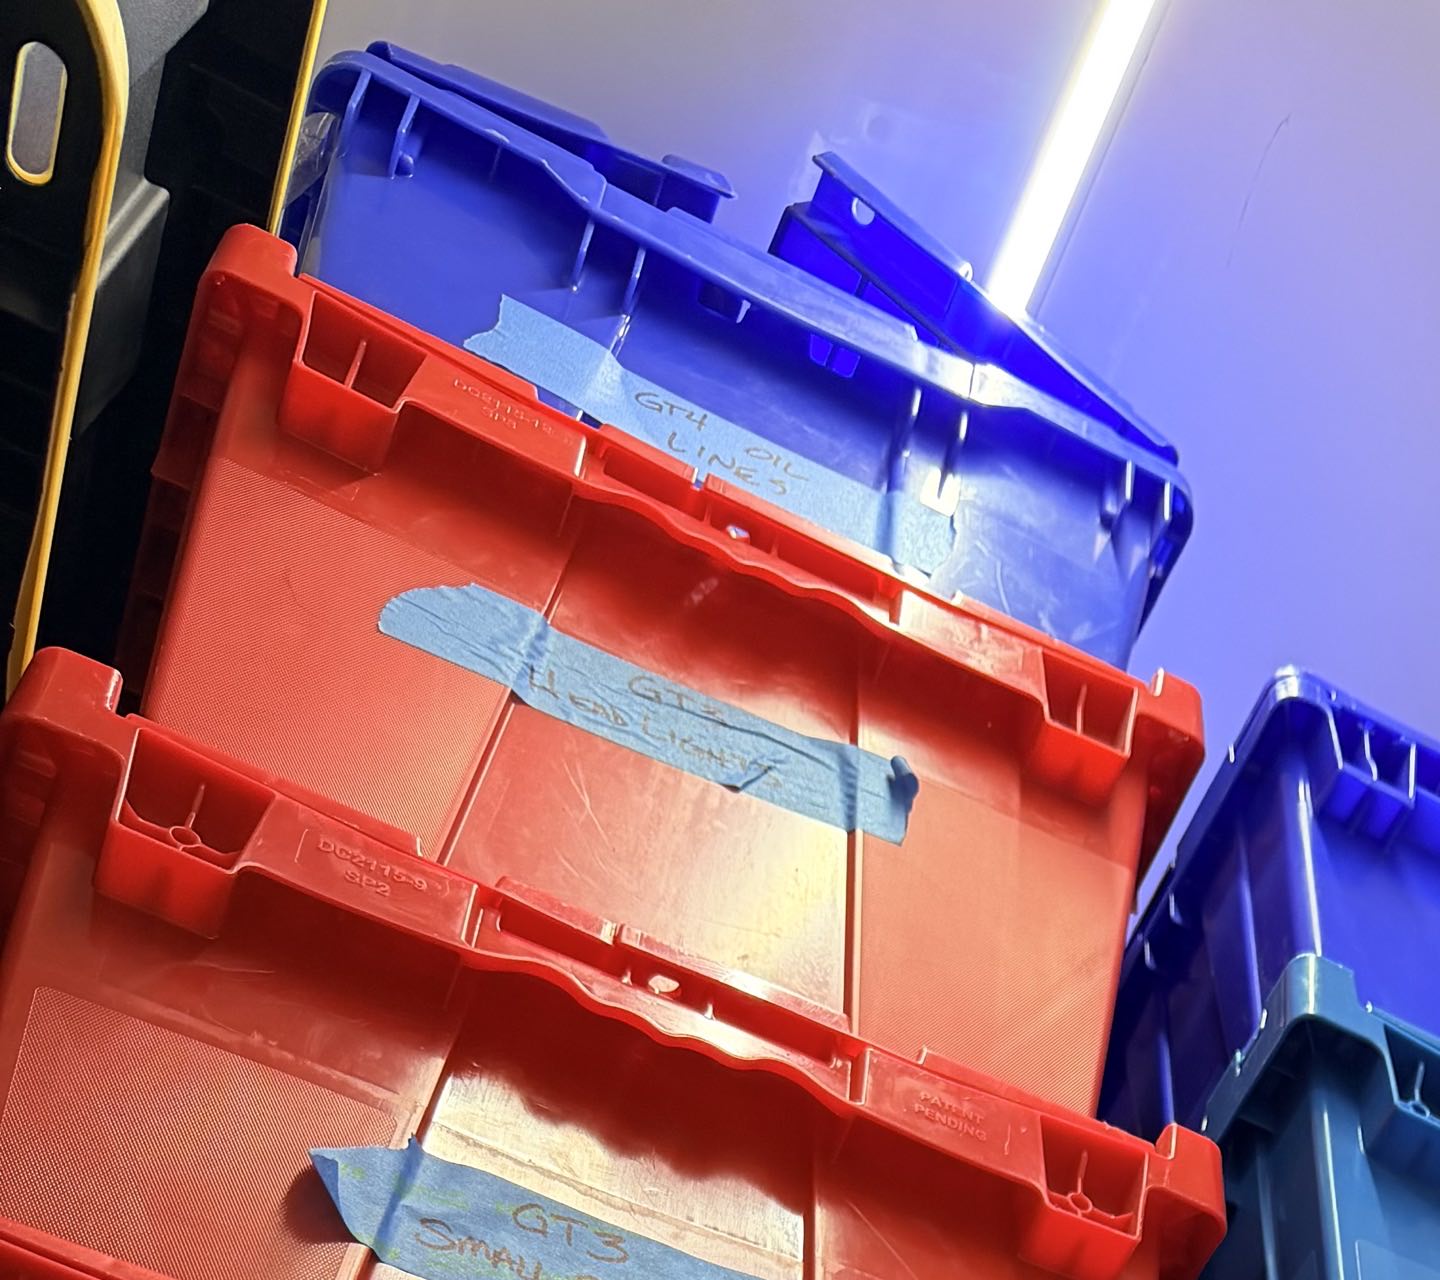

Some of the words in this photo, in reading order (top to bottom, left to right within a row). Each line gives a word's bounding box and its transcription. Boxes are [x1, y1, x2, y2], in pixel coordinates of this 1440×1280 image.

[634, 391, 707, 431] GT4
[746, 446, 809, 482] OIL
[667, 431, 787, 496] LINES
[511, 1203, 629, 1263] GT3
